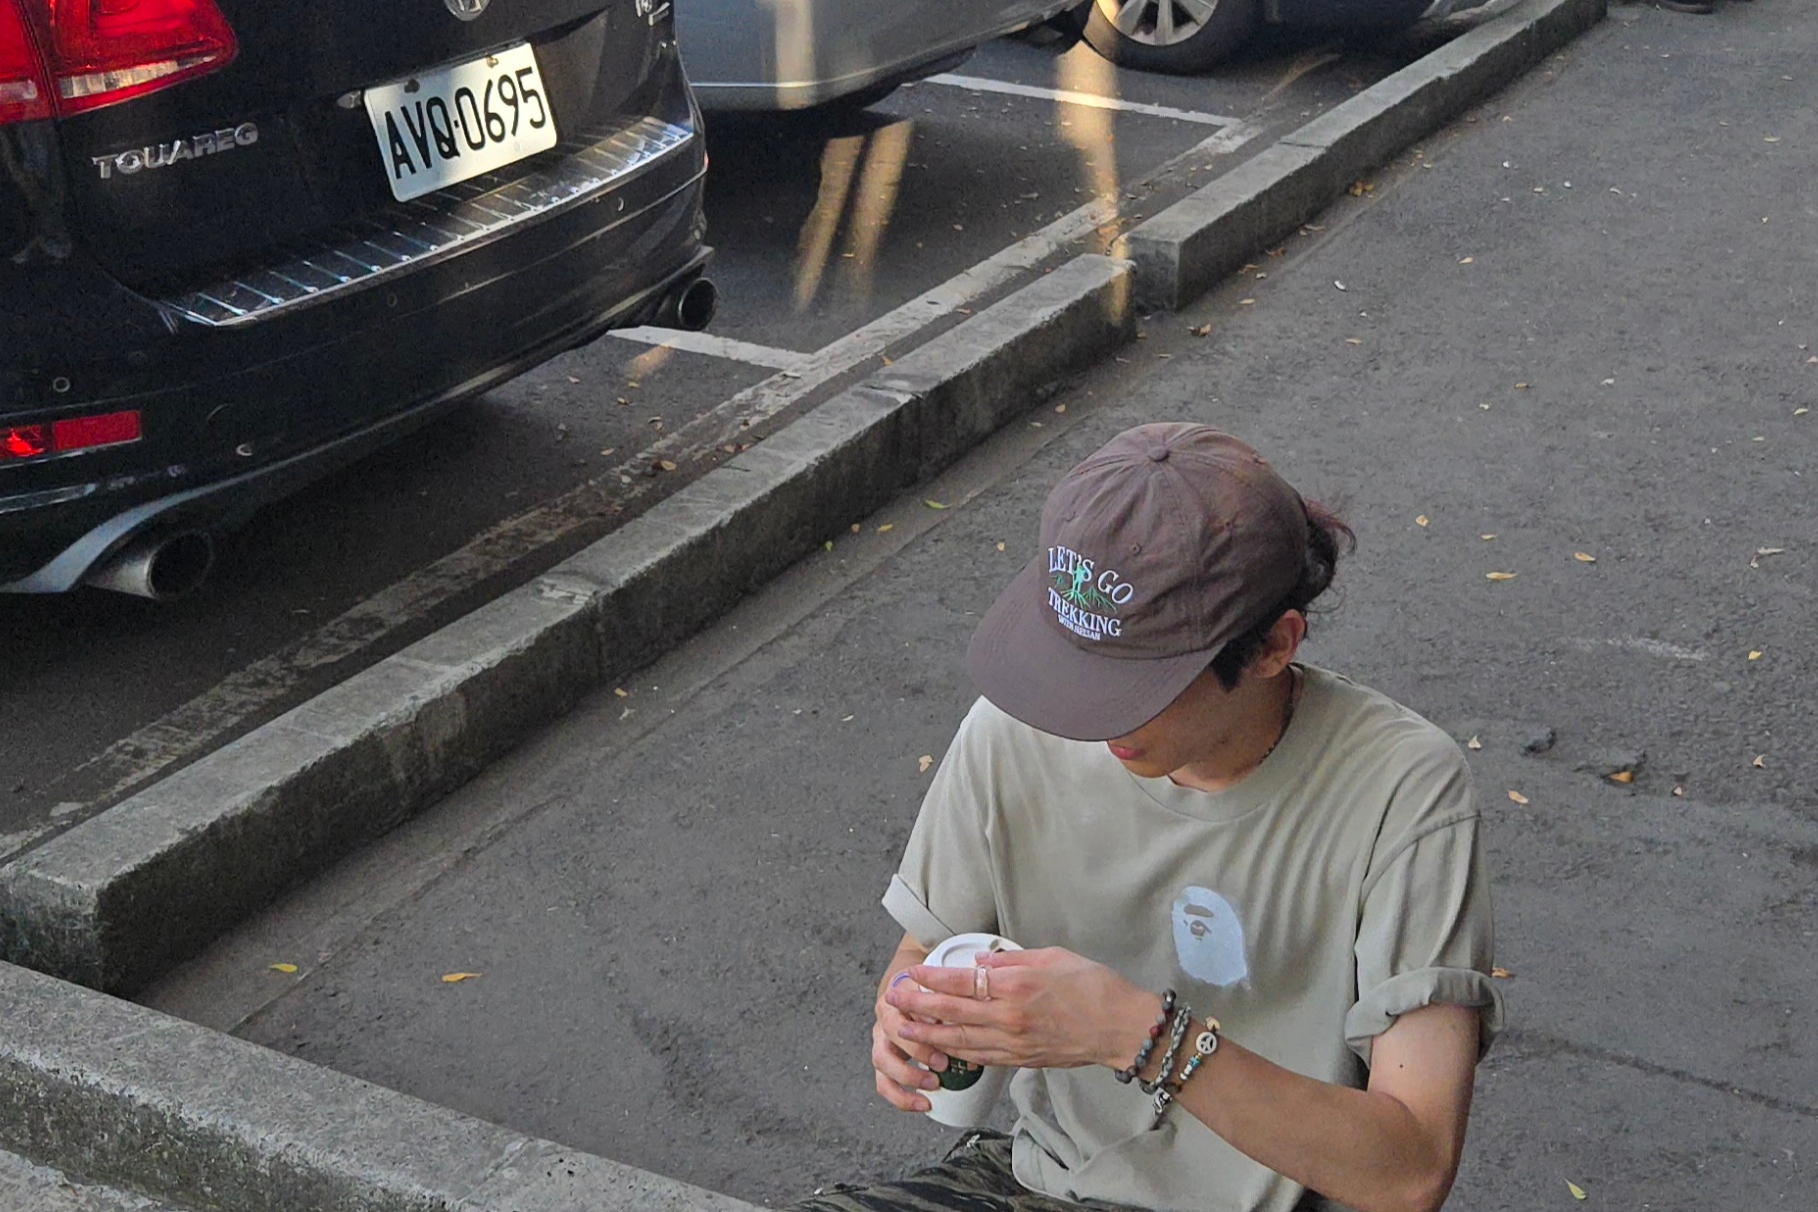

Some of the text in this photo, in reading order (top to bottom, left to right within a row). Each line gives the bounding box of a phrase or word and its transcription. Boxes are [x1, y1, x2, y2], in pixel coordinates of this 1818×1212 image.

[91, 121, 259, 180] TOUAREG
[1047, 545, 1134, 604] LET'S GO
[1047, 586, 1123, 637] TREKKING
